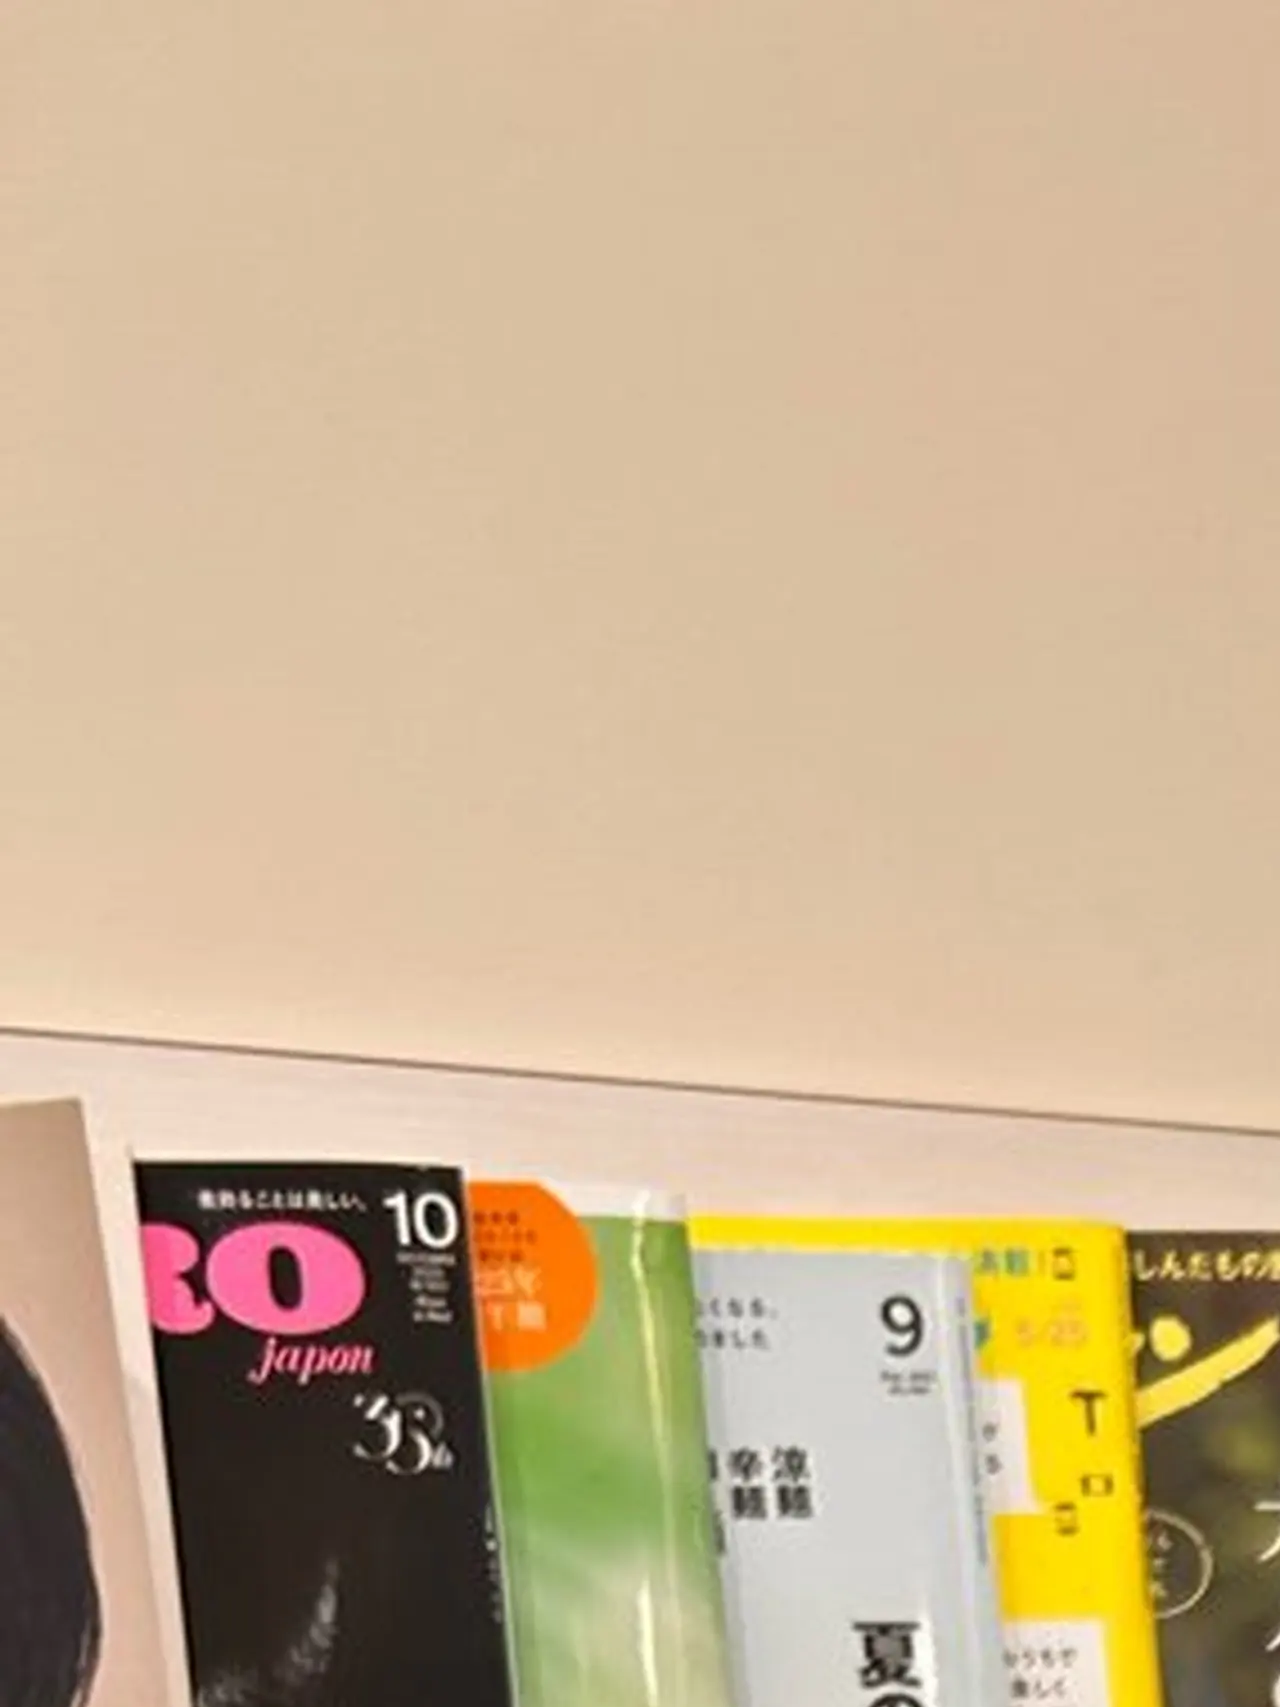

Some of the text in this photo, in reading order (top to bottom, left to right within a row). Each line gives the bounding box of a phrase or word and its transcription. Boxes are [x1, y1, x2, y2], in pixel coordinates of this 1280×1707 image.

[383, 1191, 459, 1248] 10
[882, 1294, 925, 1358] 9
[247, 1335, 374, 1385] japon
